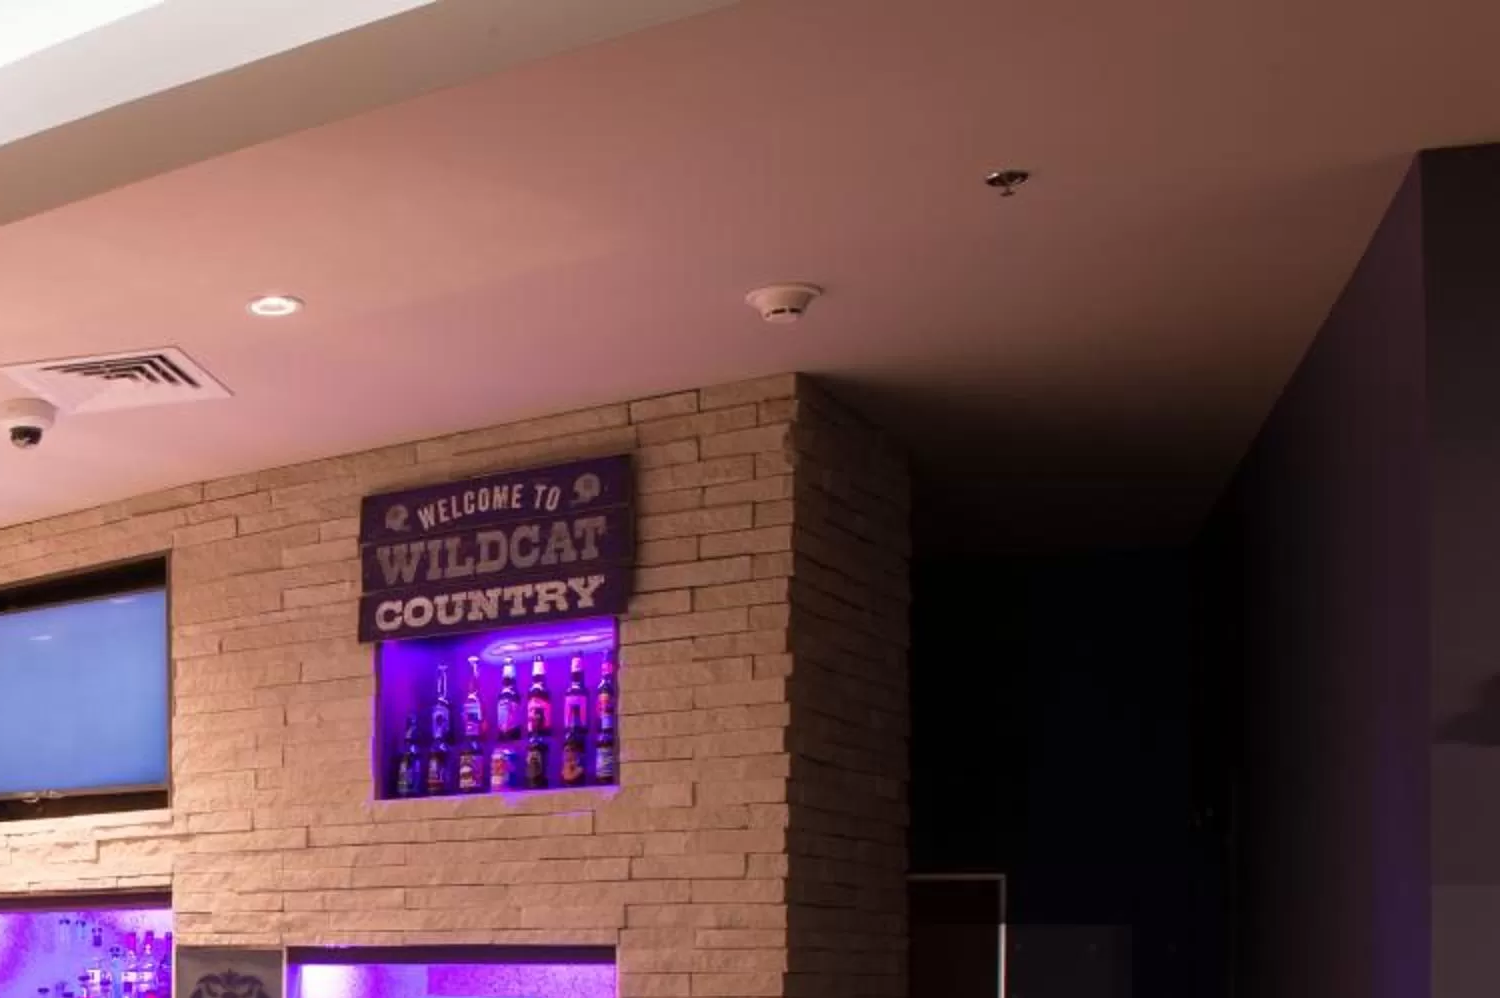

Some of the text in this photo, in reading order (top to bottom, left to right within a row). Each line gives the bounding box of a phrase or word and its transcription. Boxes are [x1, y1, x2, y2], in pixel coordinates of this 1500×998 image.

[416, 483, 562, 531] WELCOME TO
[375, 515, 607, 586] WILDCAT
[374, 574, 606, 632] COUNTRY
